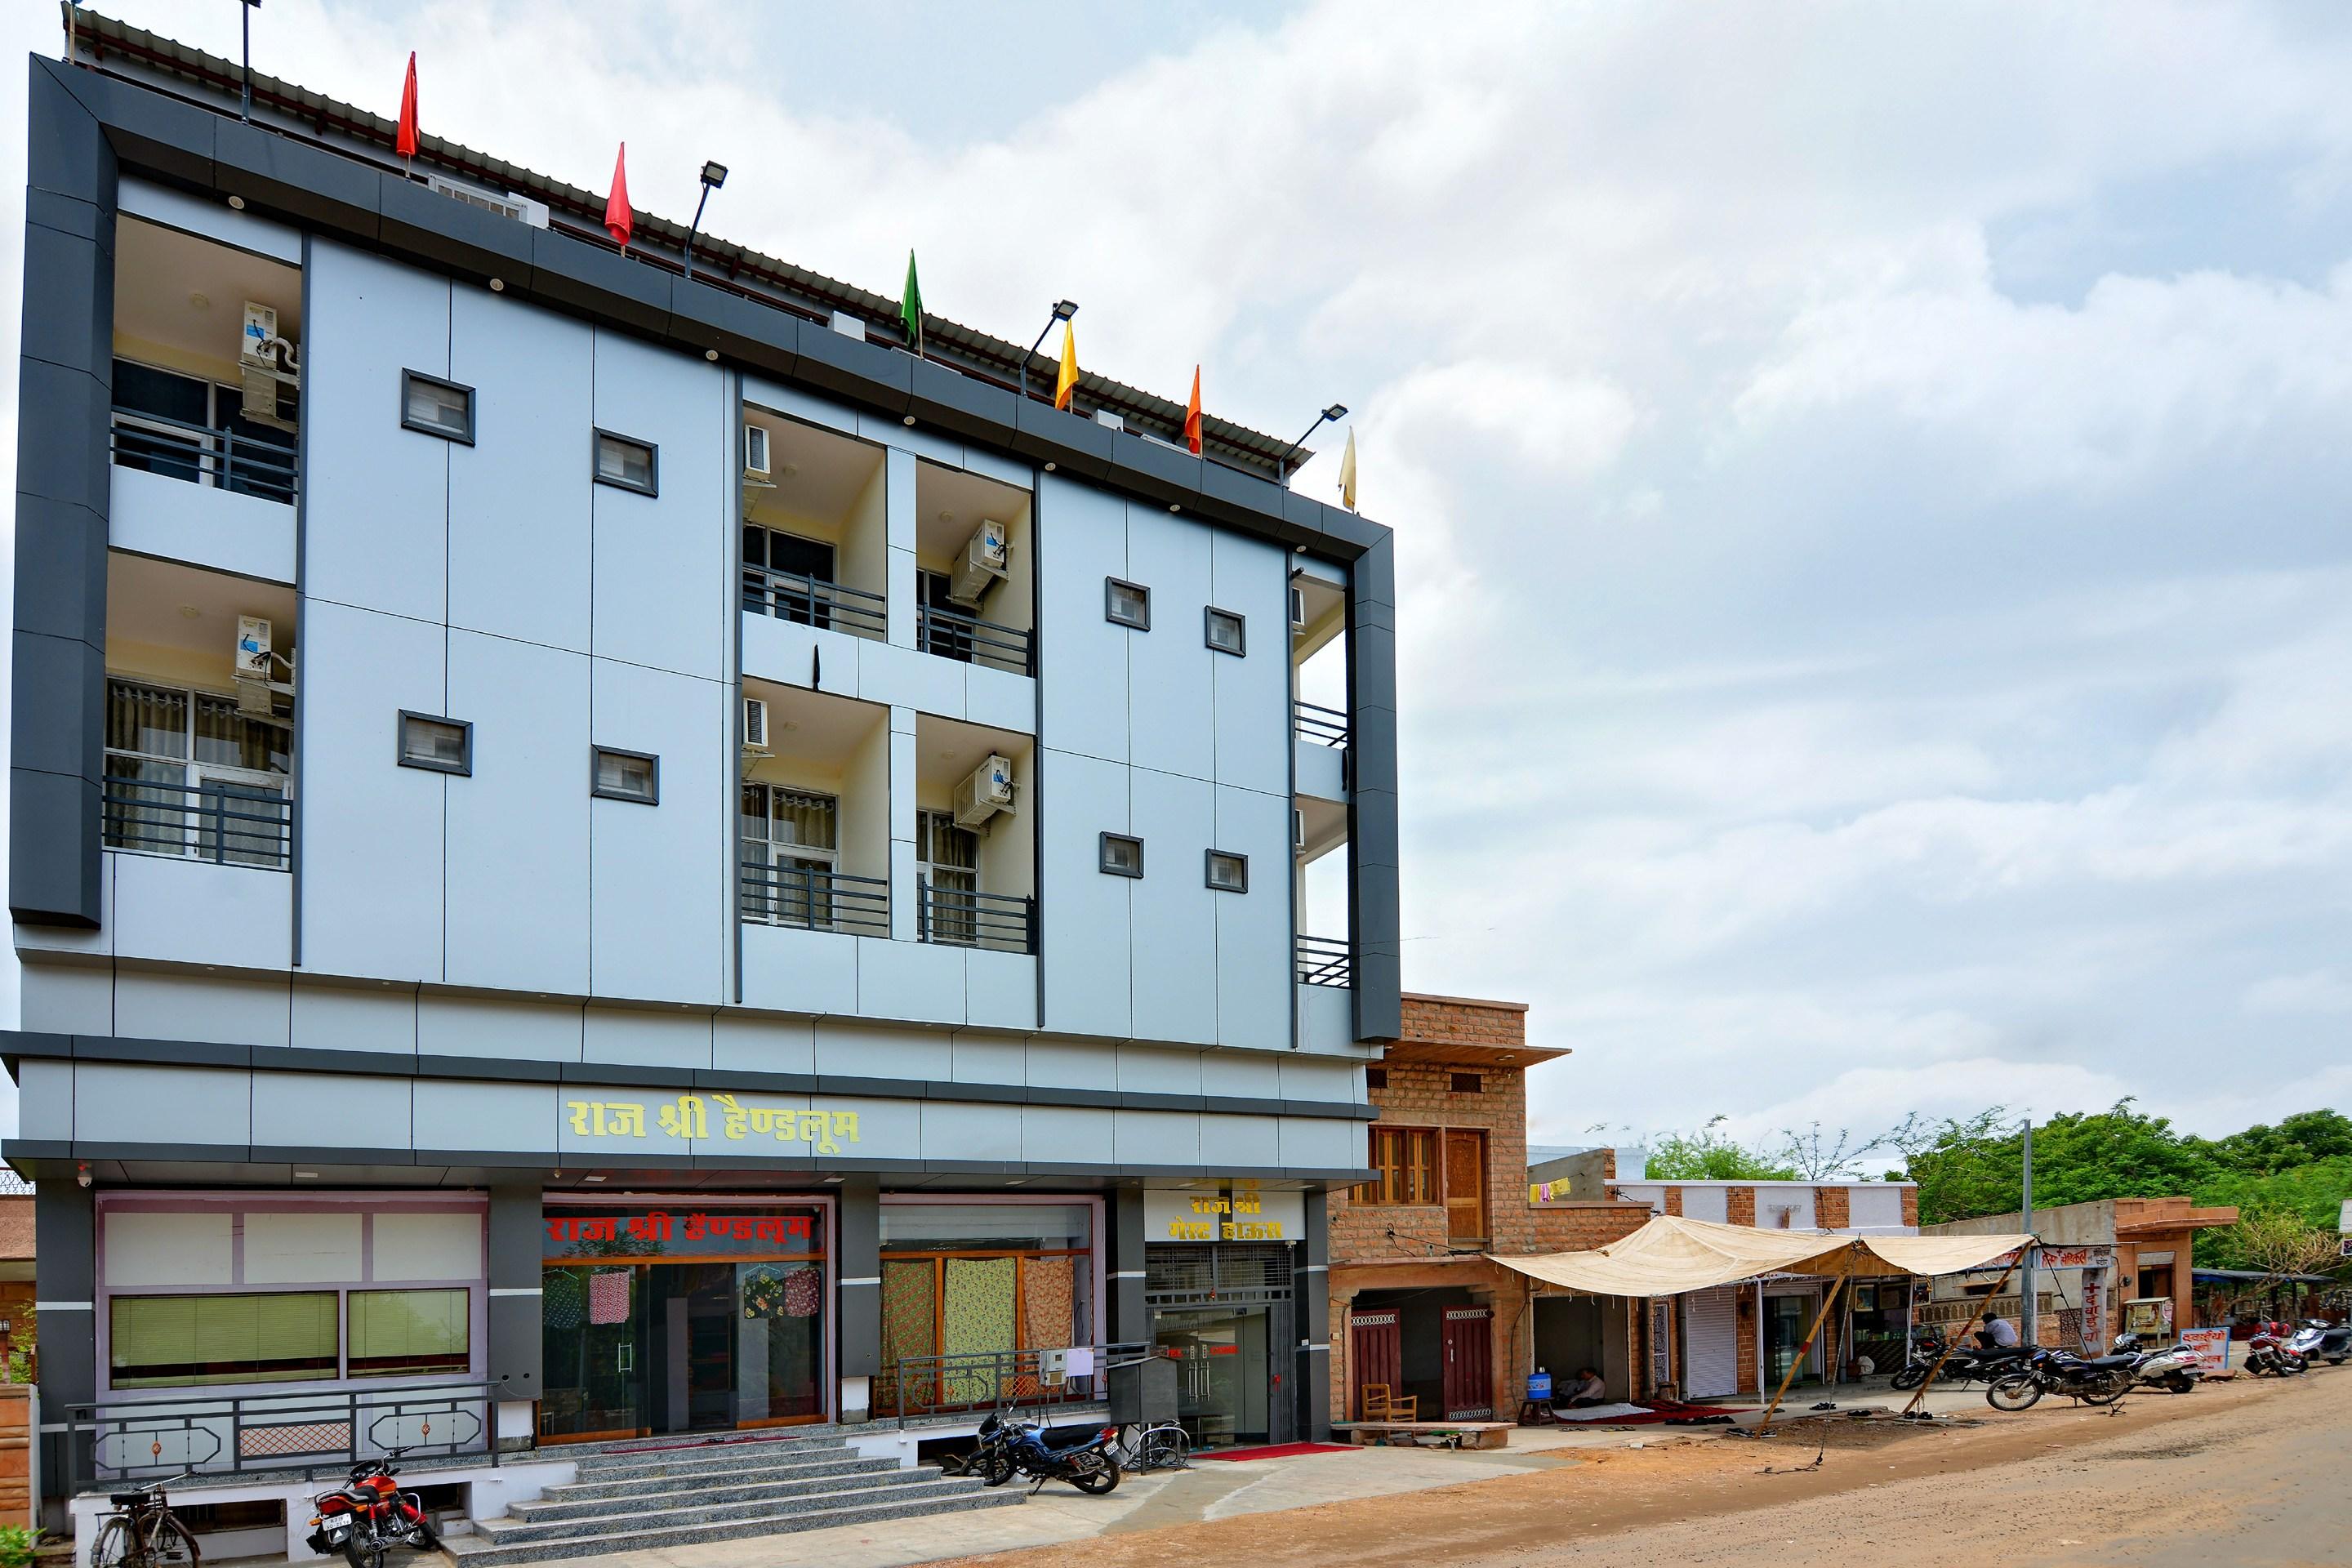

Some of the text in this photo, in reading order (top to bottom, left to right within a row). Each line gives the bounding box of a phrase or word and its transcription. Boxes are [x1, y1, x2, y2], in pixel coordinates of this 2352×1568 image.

[567, 1094, 861, 1156] राज श्री हैण्डलूम
[1189, 1192, 1262, 1214] राज श्री
[545, 1216, 618, 1242] राज
[626, 1211, 676, 1242] श्री
[1168, 1215, 1212, 1240] गेस्ट
